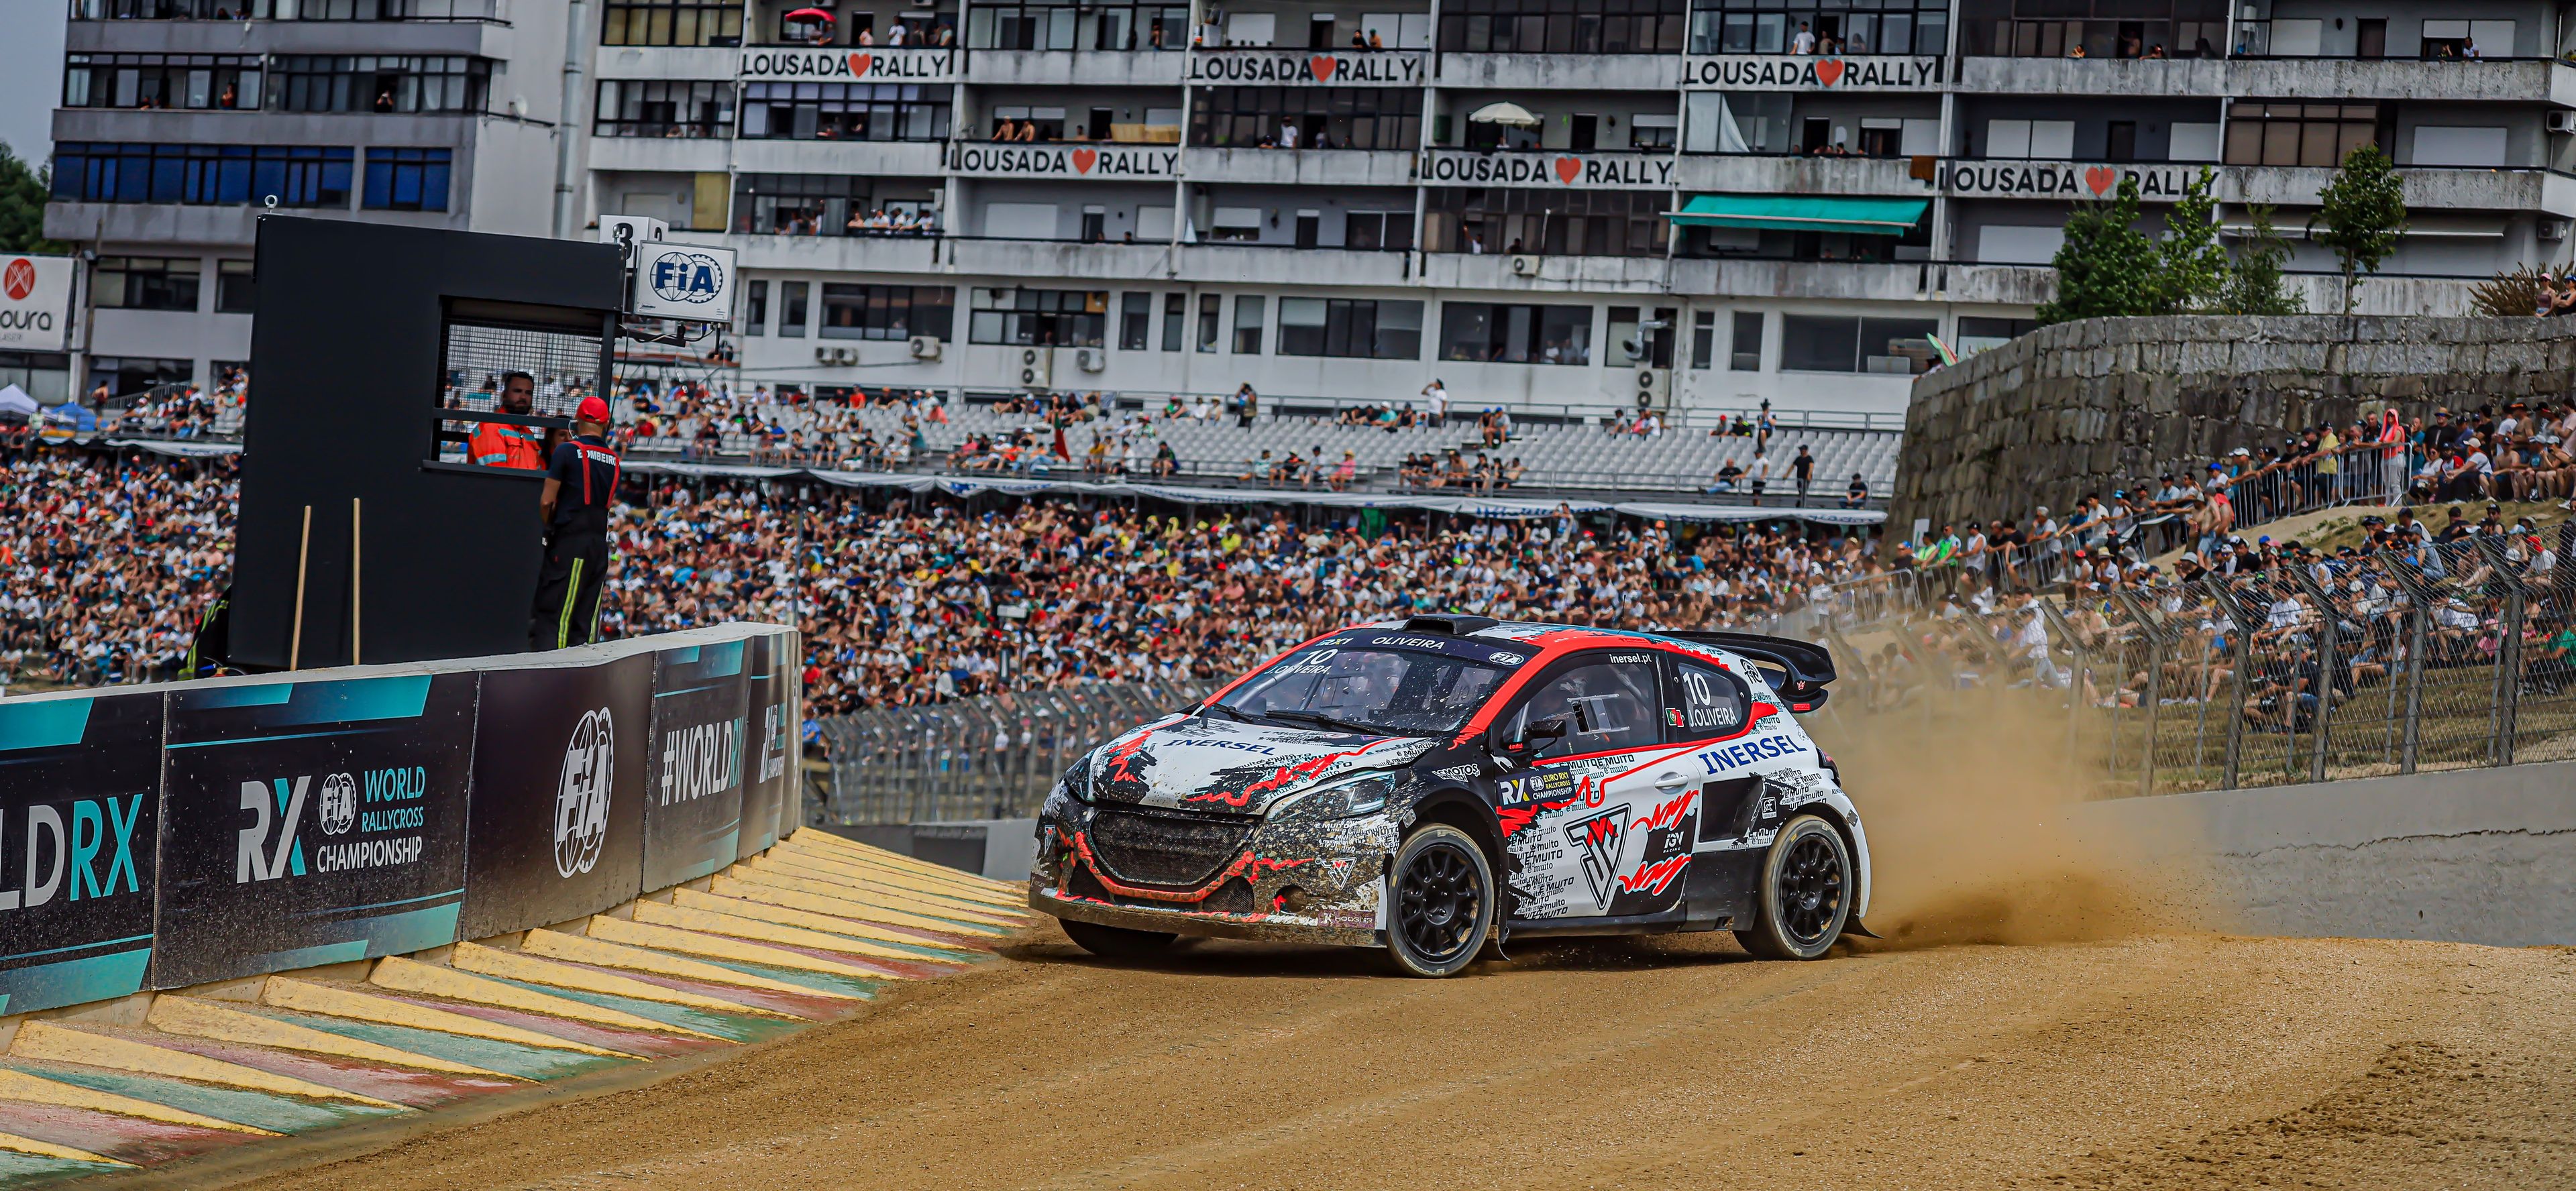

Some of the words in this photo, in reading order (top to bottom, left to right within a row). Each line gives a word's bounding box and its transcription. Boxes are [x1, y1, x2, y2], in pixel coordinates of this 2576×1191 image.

[741, 53, 850, 76] LOUSADA
[870, 55, 946, 77] RALLY
[1191, 56, 1313, 81] LOUSADA
[1335, 58, 1417, 82] RALLY
[1683, 60, 1819, 86] LOUSADA
[1843, 62, 1934, 86] RALLY
[950, 148, 1067, 173] LOUSADA
[1098, 151, 1179, 175] RALLY
[1421, 157, 1548, 182] LOUSADA
[1586, 160, 1674, 184] RALLY
[612, 223, 633, 260] 3
[1372, 636, 1445, 650] OLIVEIRA
[1298, 648, 1338, 665] 10
[1609, 653, 1652, 665] inersel.pt
[1682, 671, 1711, 706] 10
[1688, 707, 1738, 728] J.OLIVEIRA
[1163, 739, 1276, 756] INERSEL
[1698, 735, 1808, 775] INERSEL
[1605, 754, 1635, 765] MUITO
[1611, 764, 1629, 774] muito
[1544, 774, 1558, 783] EURO
[1558, 772, 1569, 781] RX1
[1546, 779, 1571, 789] RALLYCROSS
[1801, 773, 1823, 783] MUITO
[1499, 778, 1530, 805] RX
[1533, 787, 1572, 800] CHAMPIONSHIP
[1806, 789, 1824, 801] muito
[361, 806, 424, 833] RALLYCROSS
[1545, 810, 1564, 819] muito
[236, 775, 312, 884] RX
[364, 766, 426, 803] WORLD
[1539, 826, 1556, 836] muito
[1537, 839, 1559, 851] muito
[317, 836, 423, 873] CHAMPIONSHIP
[1532, 849, 1563, 864] MUITO
[1534, 862, 1554, 872] muito
[1546, 876, 1574, 892] MUITO
[1546, 887, 1564, 897] muito
[1544, 899, 1566, 911] muito
